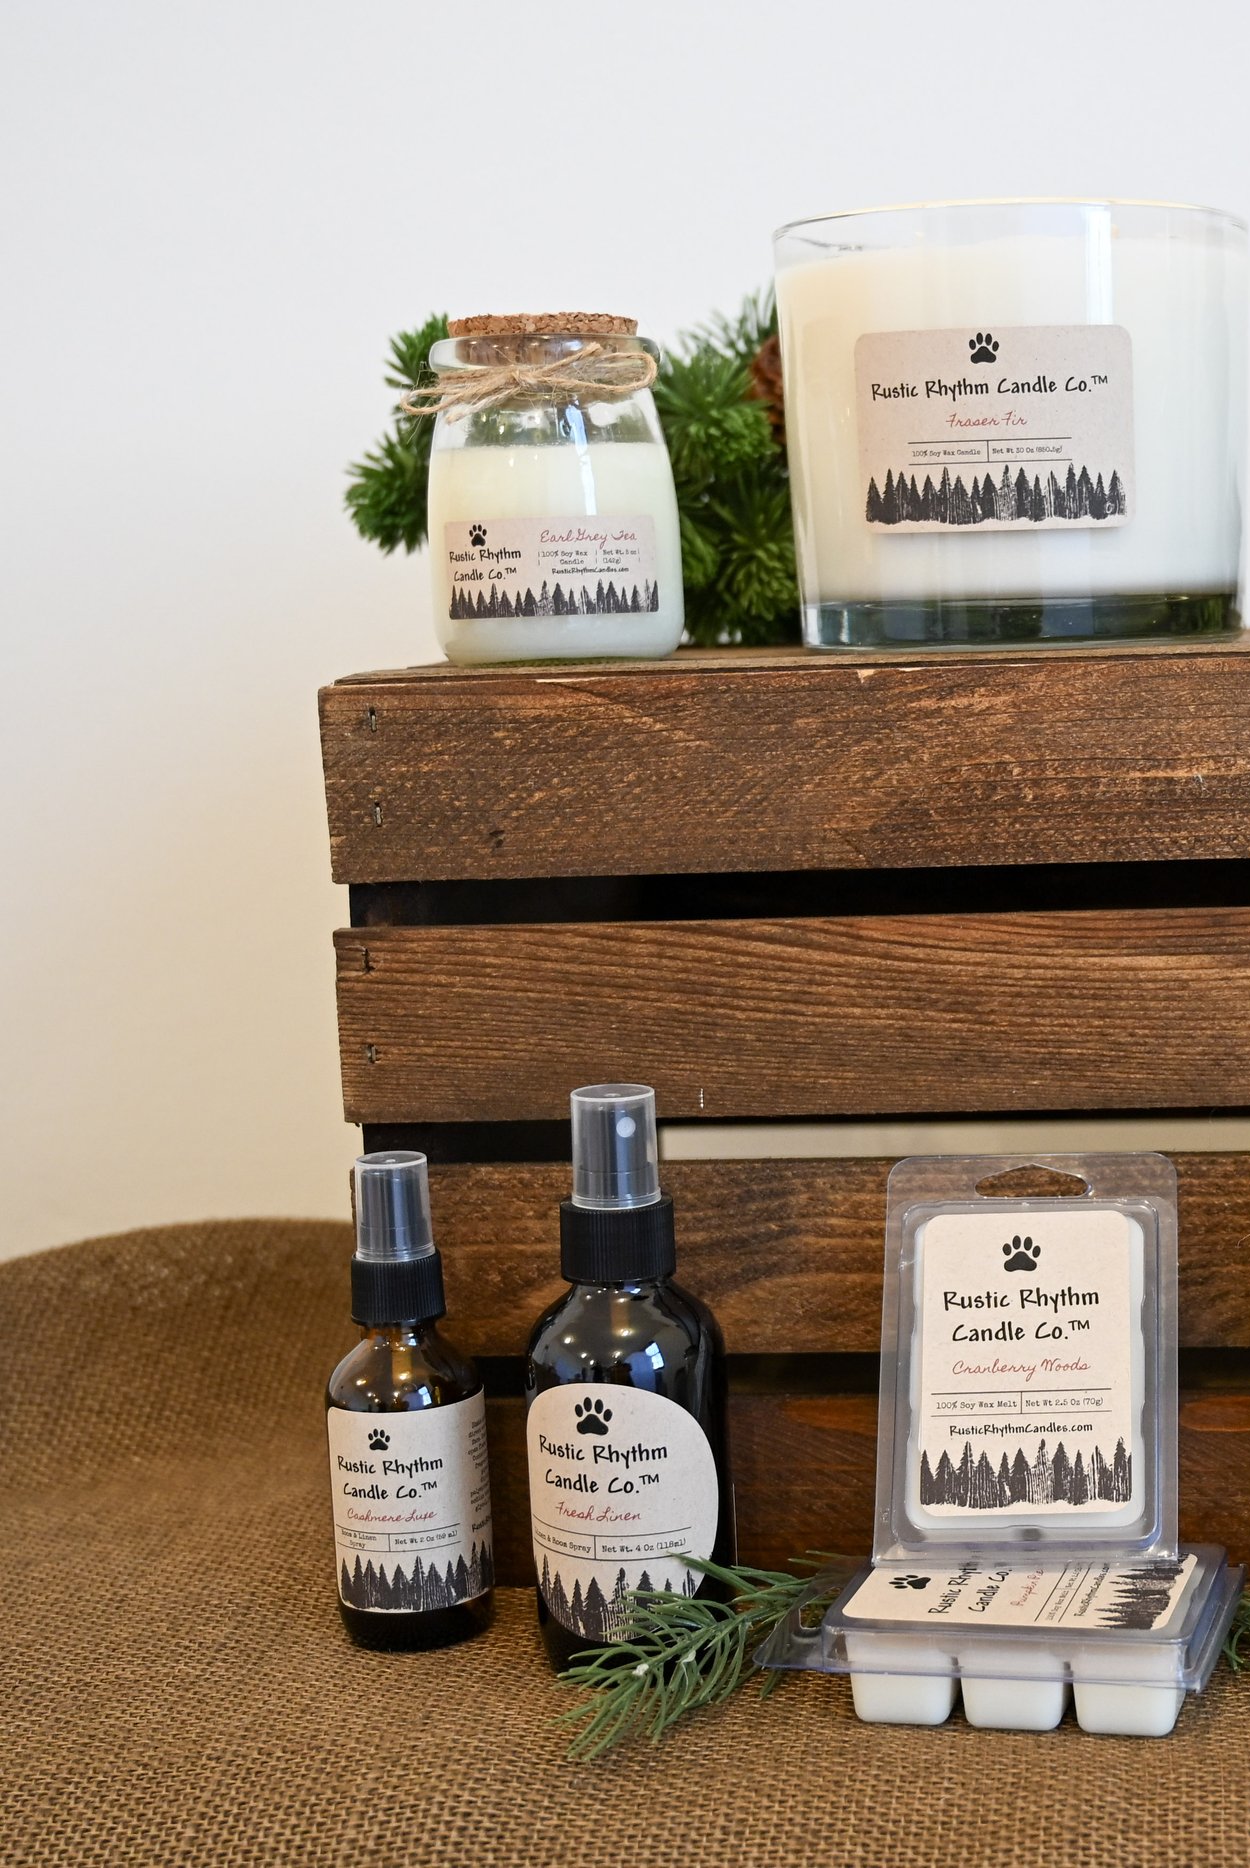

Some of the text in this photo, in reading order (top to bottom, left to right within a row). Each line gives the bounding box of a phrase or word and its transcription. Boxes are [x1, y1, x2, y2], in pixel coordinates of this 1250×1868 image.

[872, 383, 918, 400] Rustic
[925, 378, 989, 401] Rhythm
[997, 376, 1057, 394] Candle
[946, 411, 1027, 428] Fraser Fir
[540, 529, 637, 549] Earl Grey Tea
[450, 547, 521, 564] Rustic Rhythm
[453, 569, 484, 581] Candle
[944, 1287, 1099, 1313] Rustic Rhythm
[952, 1321, 1025, 1341] Candle
[952, 1357, 1091, 1382] Cranberry Woods
[936, 1399, 1017, 1410] 100% Soy Wax Melt
[1025, 1397, 1103, 1407] Net Wt 2.5 Oz (70g)
[949, 1422, 1093, 1437] RusticRhythmCandles.com
[539, 1434, 668, 1469] Rustic Rhythm
[338, 1456, 443, 1478] Rustic Rhythm
[344, 1483, 388, 1499] Candle
[546, 1469, 599, 1493] Candle
[347, 1508, 437, 1522] Cashmere Luxe
[556, 1501, 641, 1522] Fresh Linen
[569, 1543, 591, 1553] Spray
[644, 1543, 654, 1551] Oz
[928, 1588, 961, 1614] Rustic
[968, 1585, 1000, 1612] Candle
